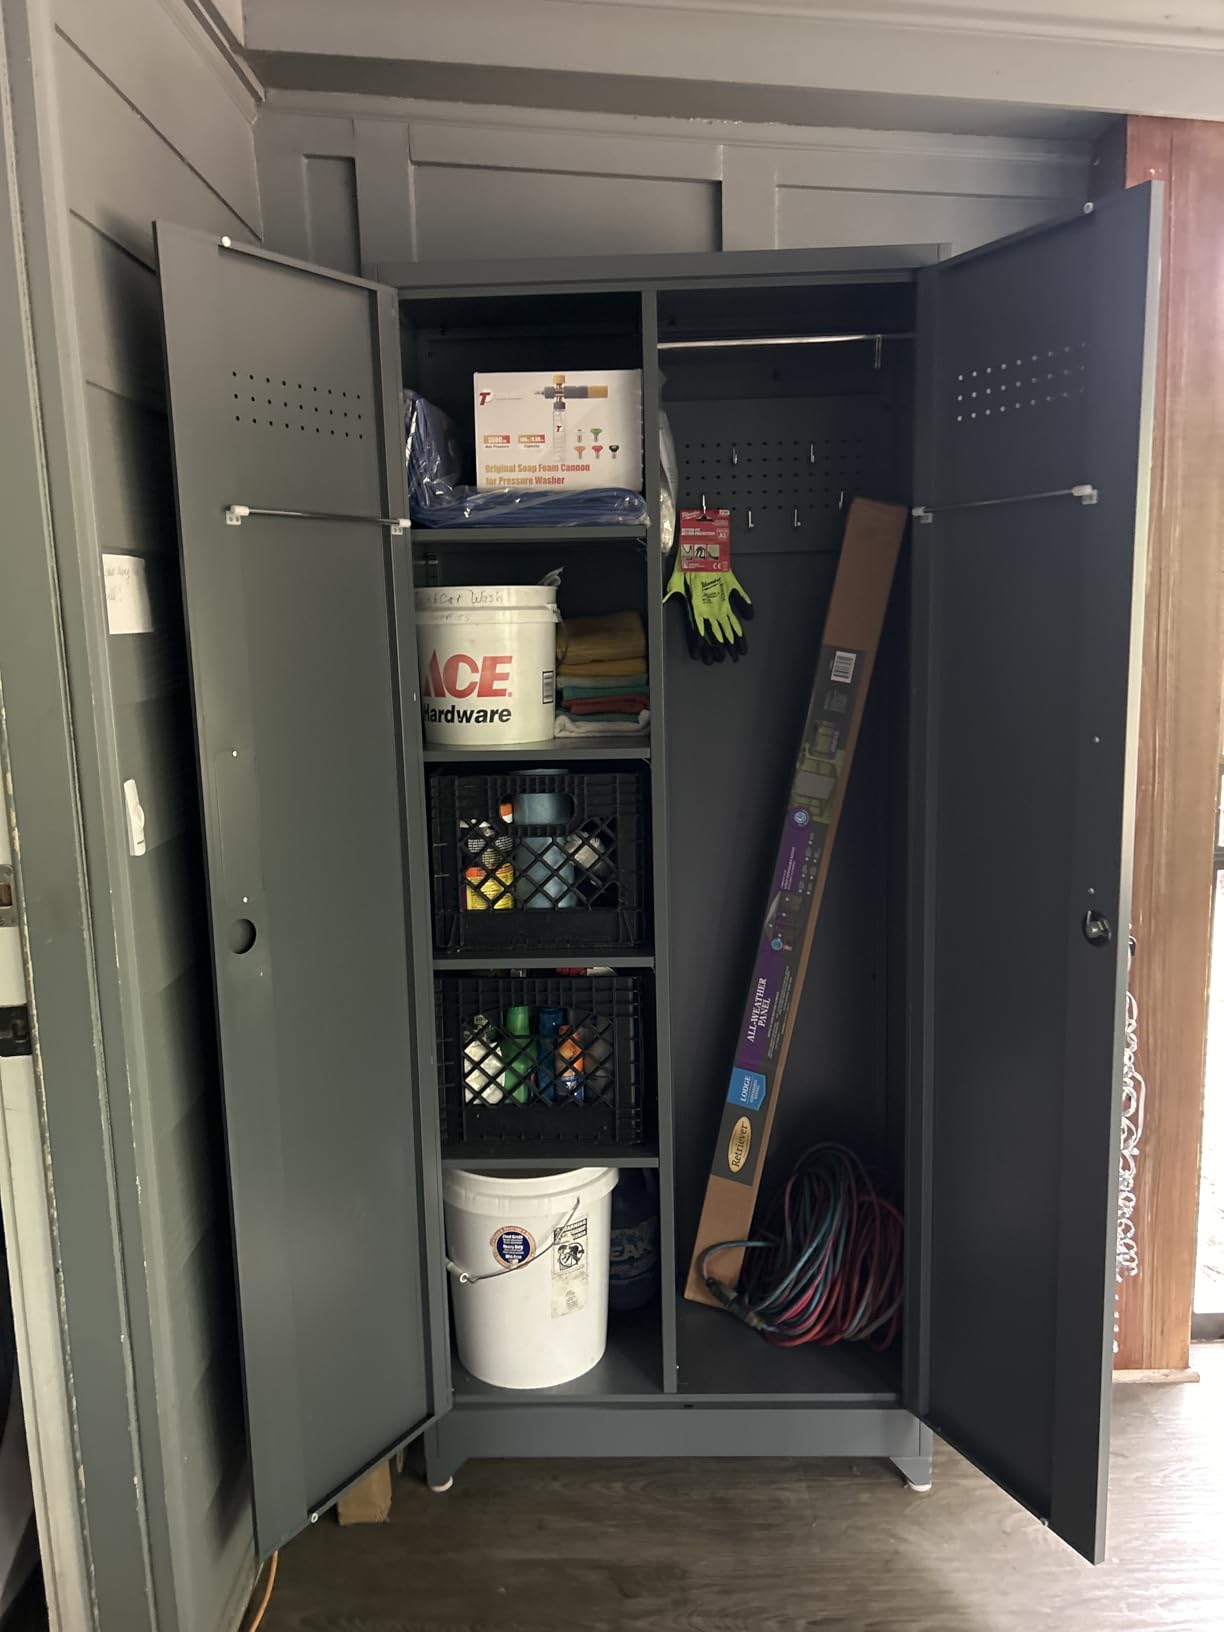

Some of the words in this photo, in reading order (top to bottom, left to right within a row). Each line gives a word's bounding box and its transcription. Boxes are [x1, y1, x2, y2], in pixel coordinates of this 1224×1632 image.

[485, 464, 516, 474] Original
[517, 464, 537, 473] Soap
[538, 464, 559, 472] Foam
[560, 463, 590, 472] Cannon
[498, 477, 533, 485] Pressure
[535, 476, 565, 485] Washer
[423, 704, 512, 724] Hardware
[746, 977, 768, 1043] ALL-WEATHER
[757, 998, 771, 1028] PANEL
[739, 1075, 752, 1103] LODGE
[731, 1123, 749, 1168] Retriever
